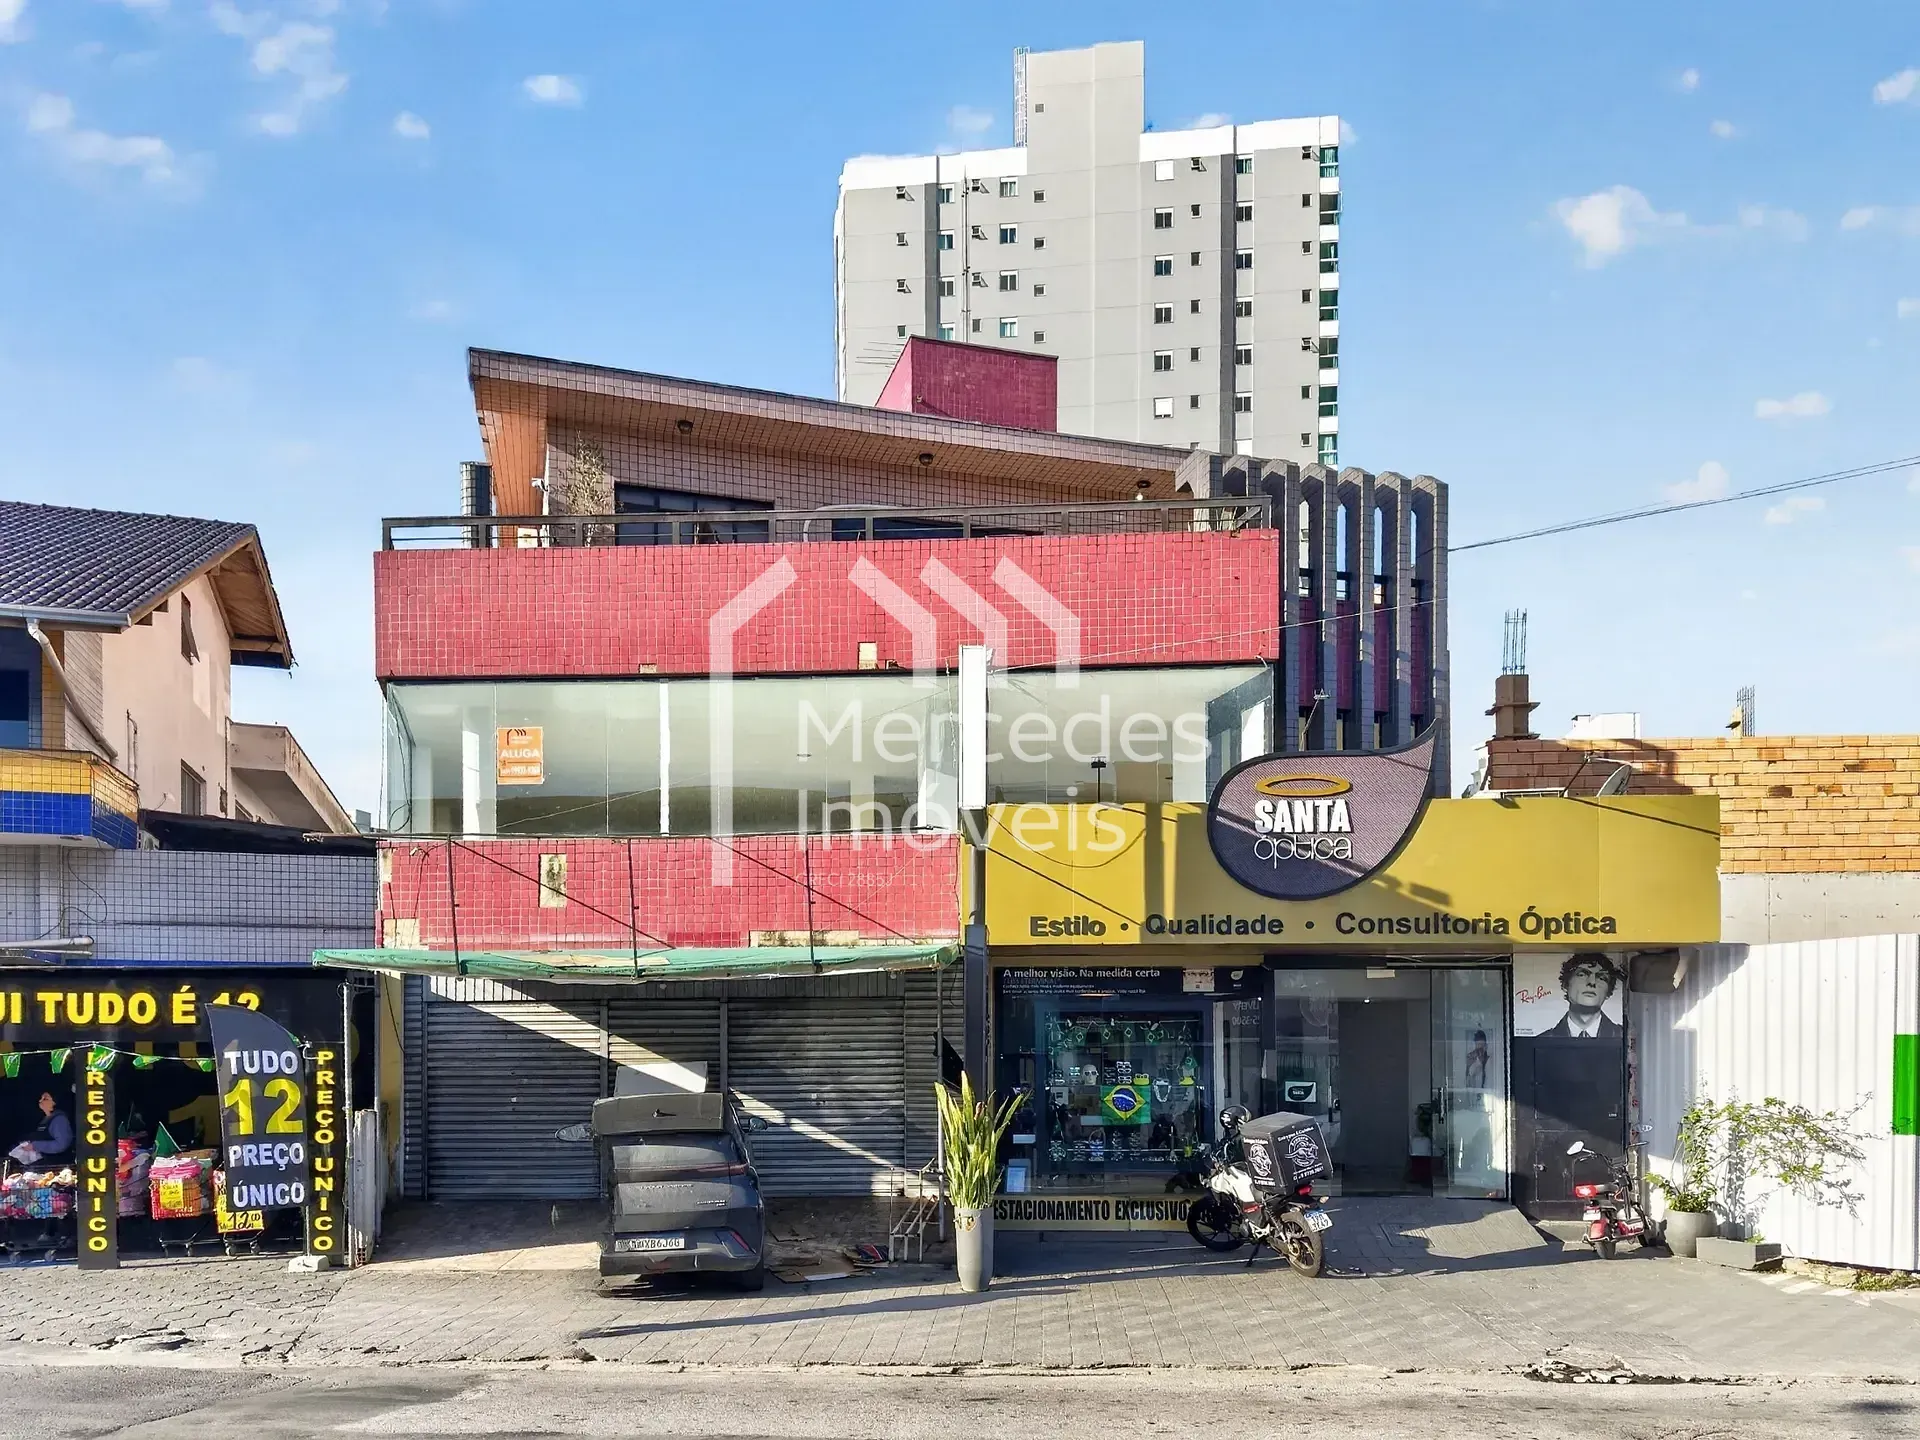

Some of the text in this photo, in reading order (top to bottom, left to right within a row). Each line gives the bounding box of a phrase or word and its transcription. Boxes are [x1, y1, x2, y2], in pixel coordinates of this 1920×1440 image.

[500, 748, 541, 758] ALUGA
[1254, 798, 1352, 833] SANTA
[1253, 834, 1354, 869] óptica
[1029, 905, 1617, 940] Estilo Qualidade Consultoria Óptica
[1003, 968, 1011, 978] A
[1014, 968, 1048, 978] melhor
[1080, 968, 1094, 978] Na
[1096, 968, 1133, 978] medida
[1135, 968, 1161, 978] certa
[0, 992, 22, 1023] I
[37, 992, 157, 1024] TUDO
[172, 985, 197, 1024] É
[1515, 985, 1553, 1004] Ray-Ban
[224, 1050, 299, 1075] TUDO
[223, 1078, 305, 1136] 12
[314, 1051, 336, 1145] PREÇO
[228, 1143, 305, 1171] PREÇO
[232, 1180, 305, 1209] ÚNICO
[994, 1199, 1188, 1222] ESTACIONAMENTO EXCLUSIVO
